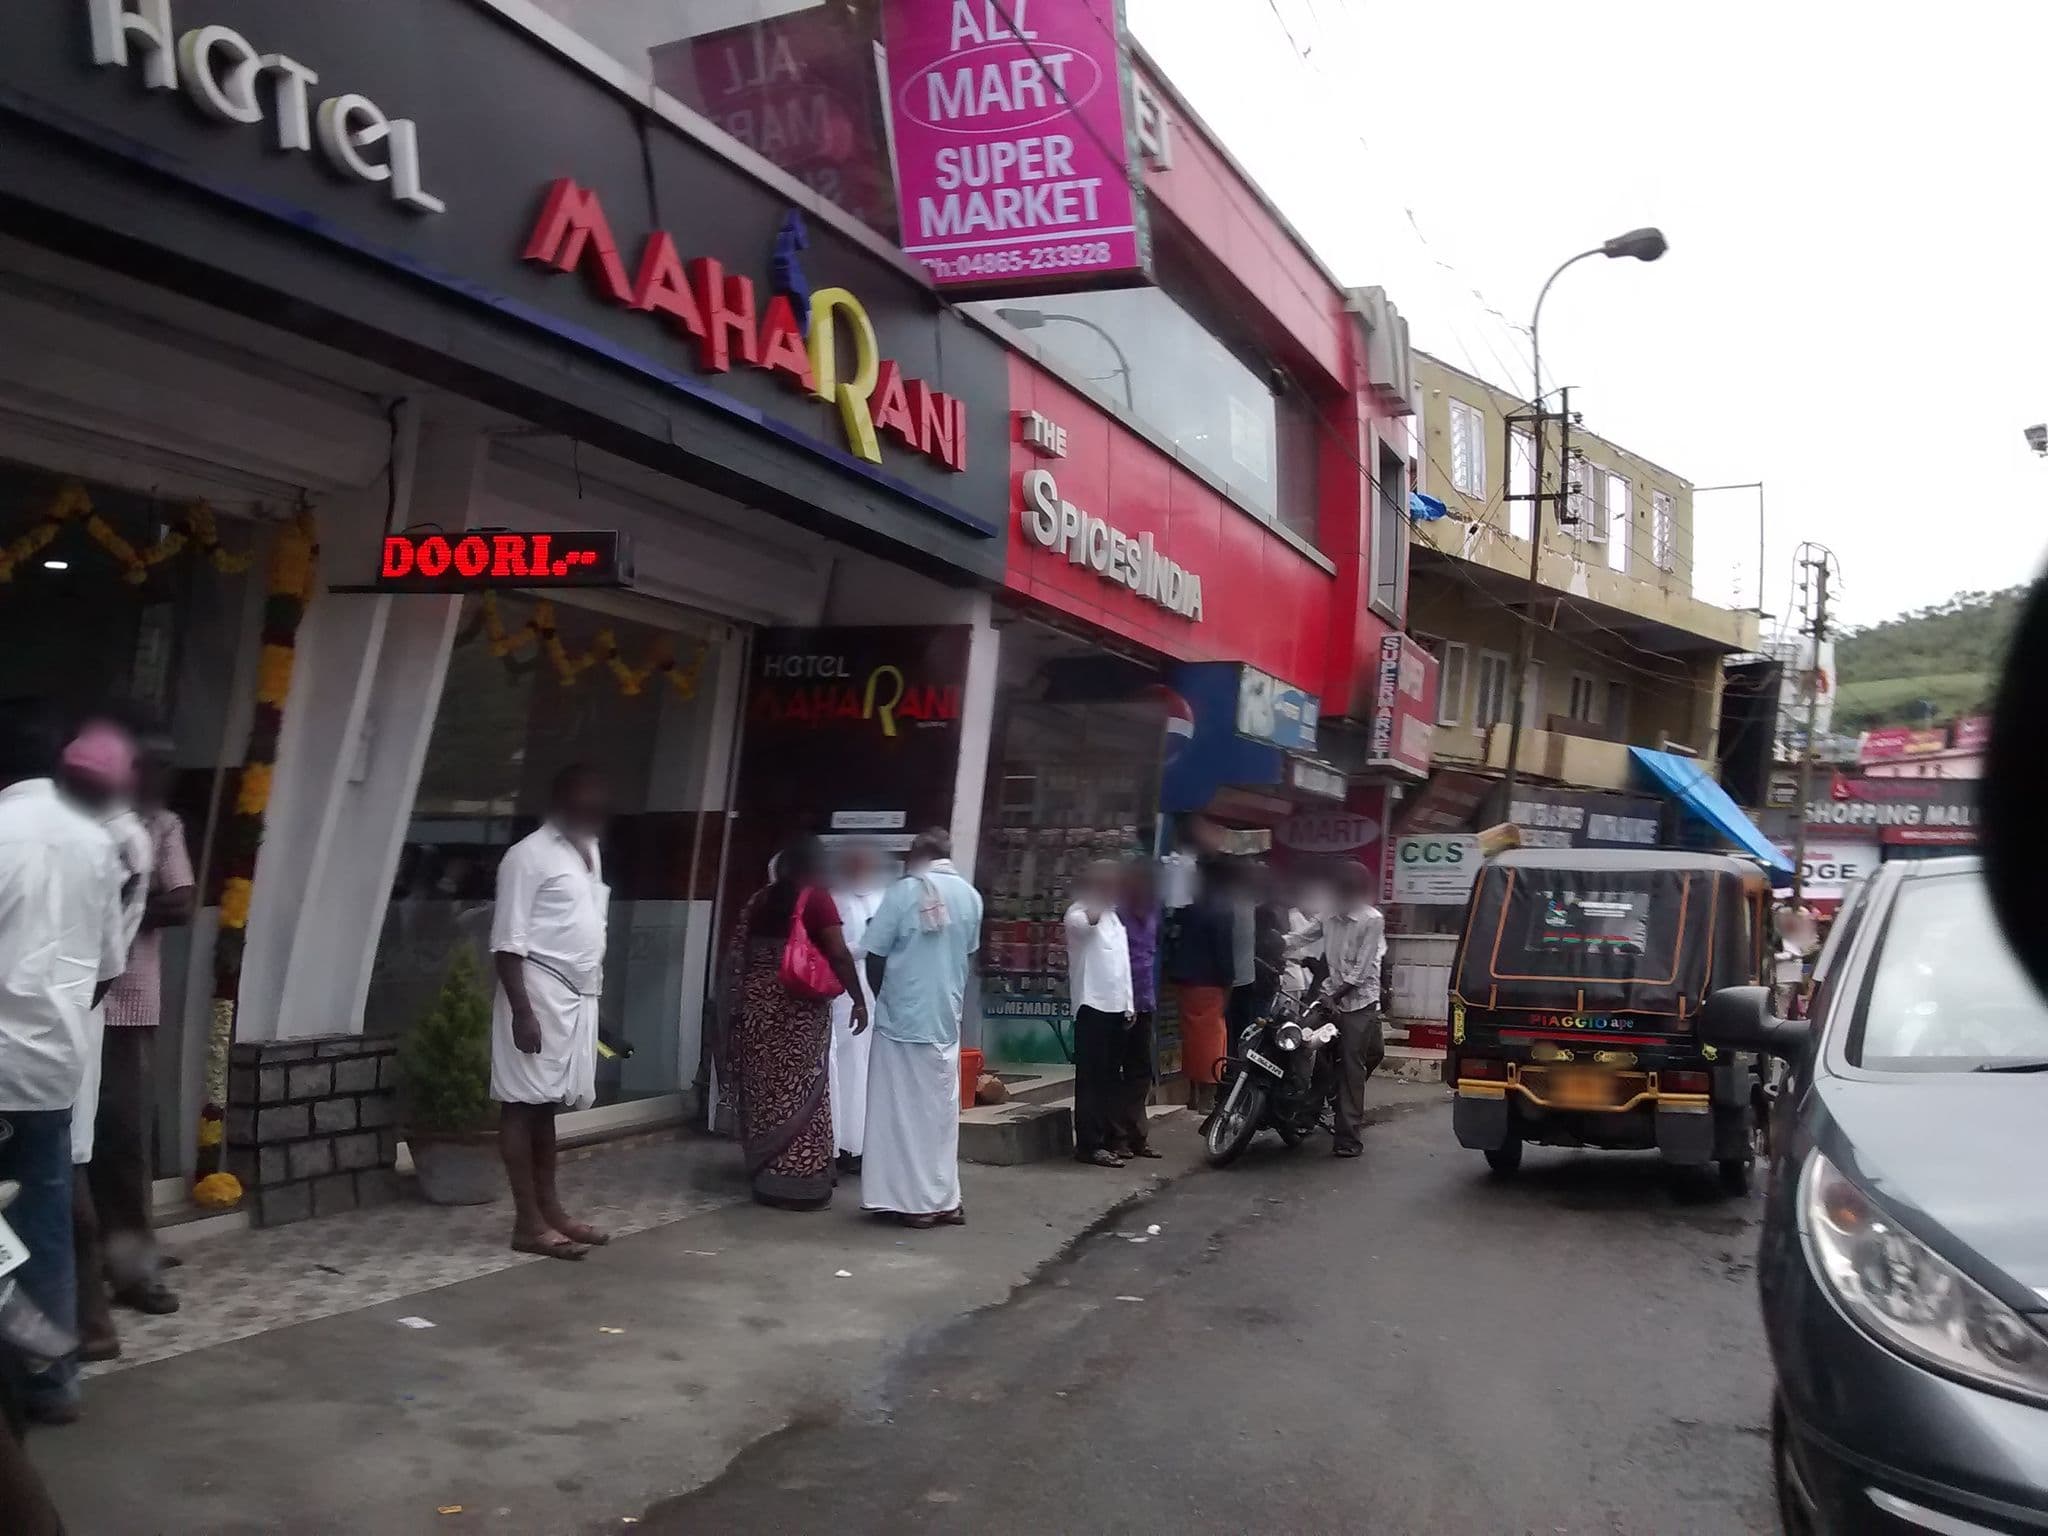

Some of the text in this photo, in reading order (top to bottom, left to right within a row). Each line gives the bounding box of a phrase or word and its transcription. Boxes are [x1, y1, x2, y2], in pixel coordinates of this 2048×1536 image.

[951, 0, 1038, 50] ALL
[927, 53, 1074, 122] MART
[935, 135, 1076, 190] SUPER
[918, 178, 1102, 238] MARKET
[522, 176, 967, 473] MAHARANI
[1020, 410, 1067, 458] THE
[1804, 802, 1922, 826] SHOPPING
[1401, 842, 1464, 864] CCS
[1529, 1015, 1608, 1029] PIAGGIO
